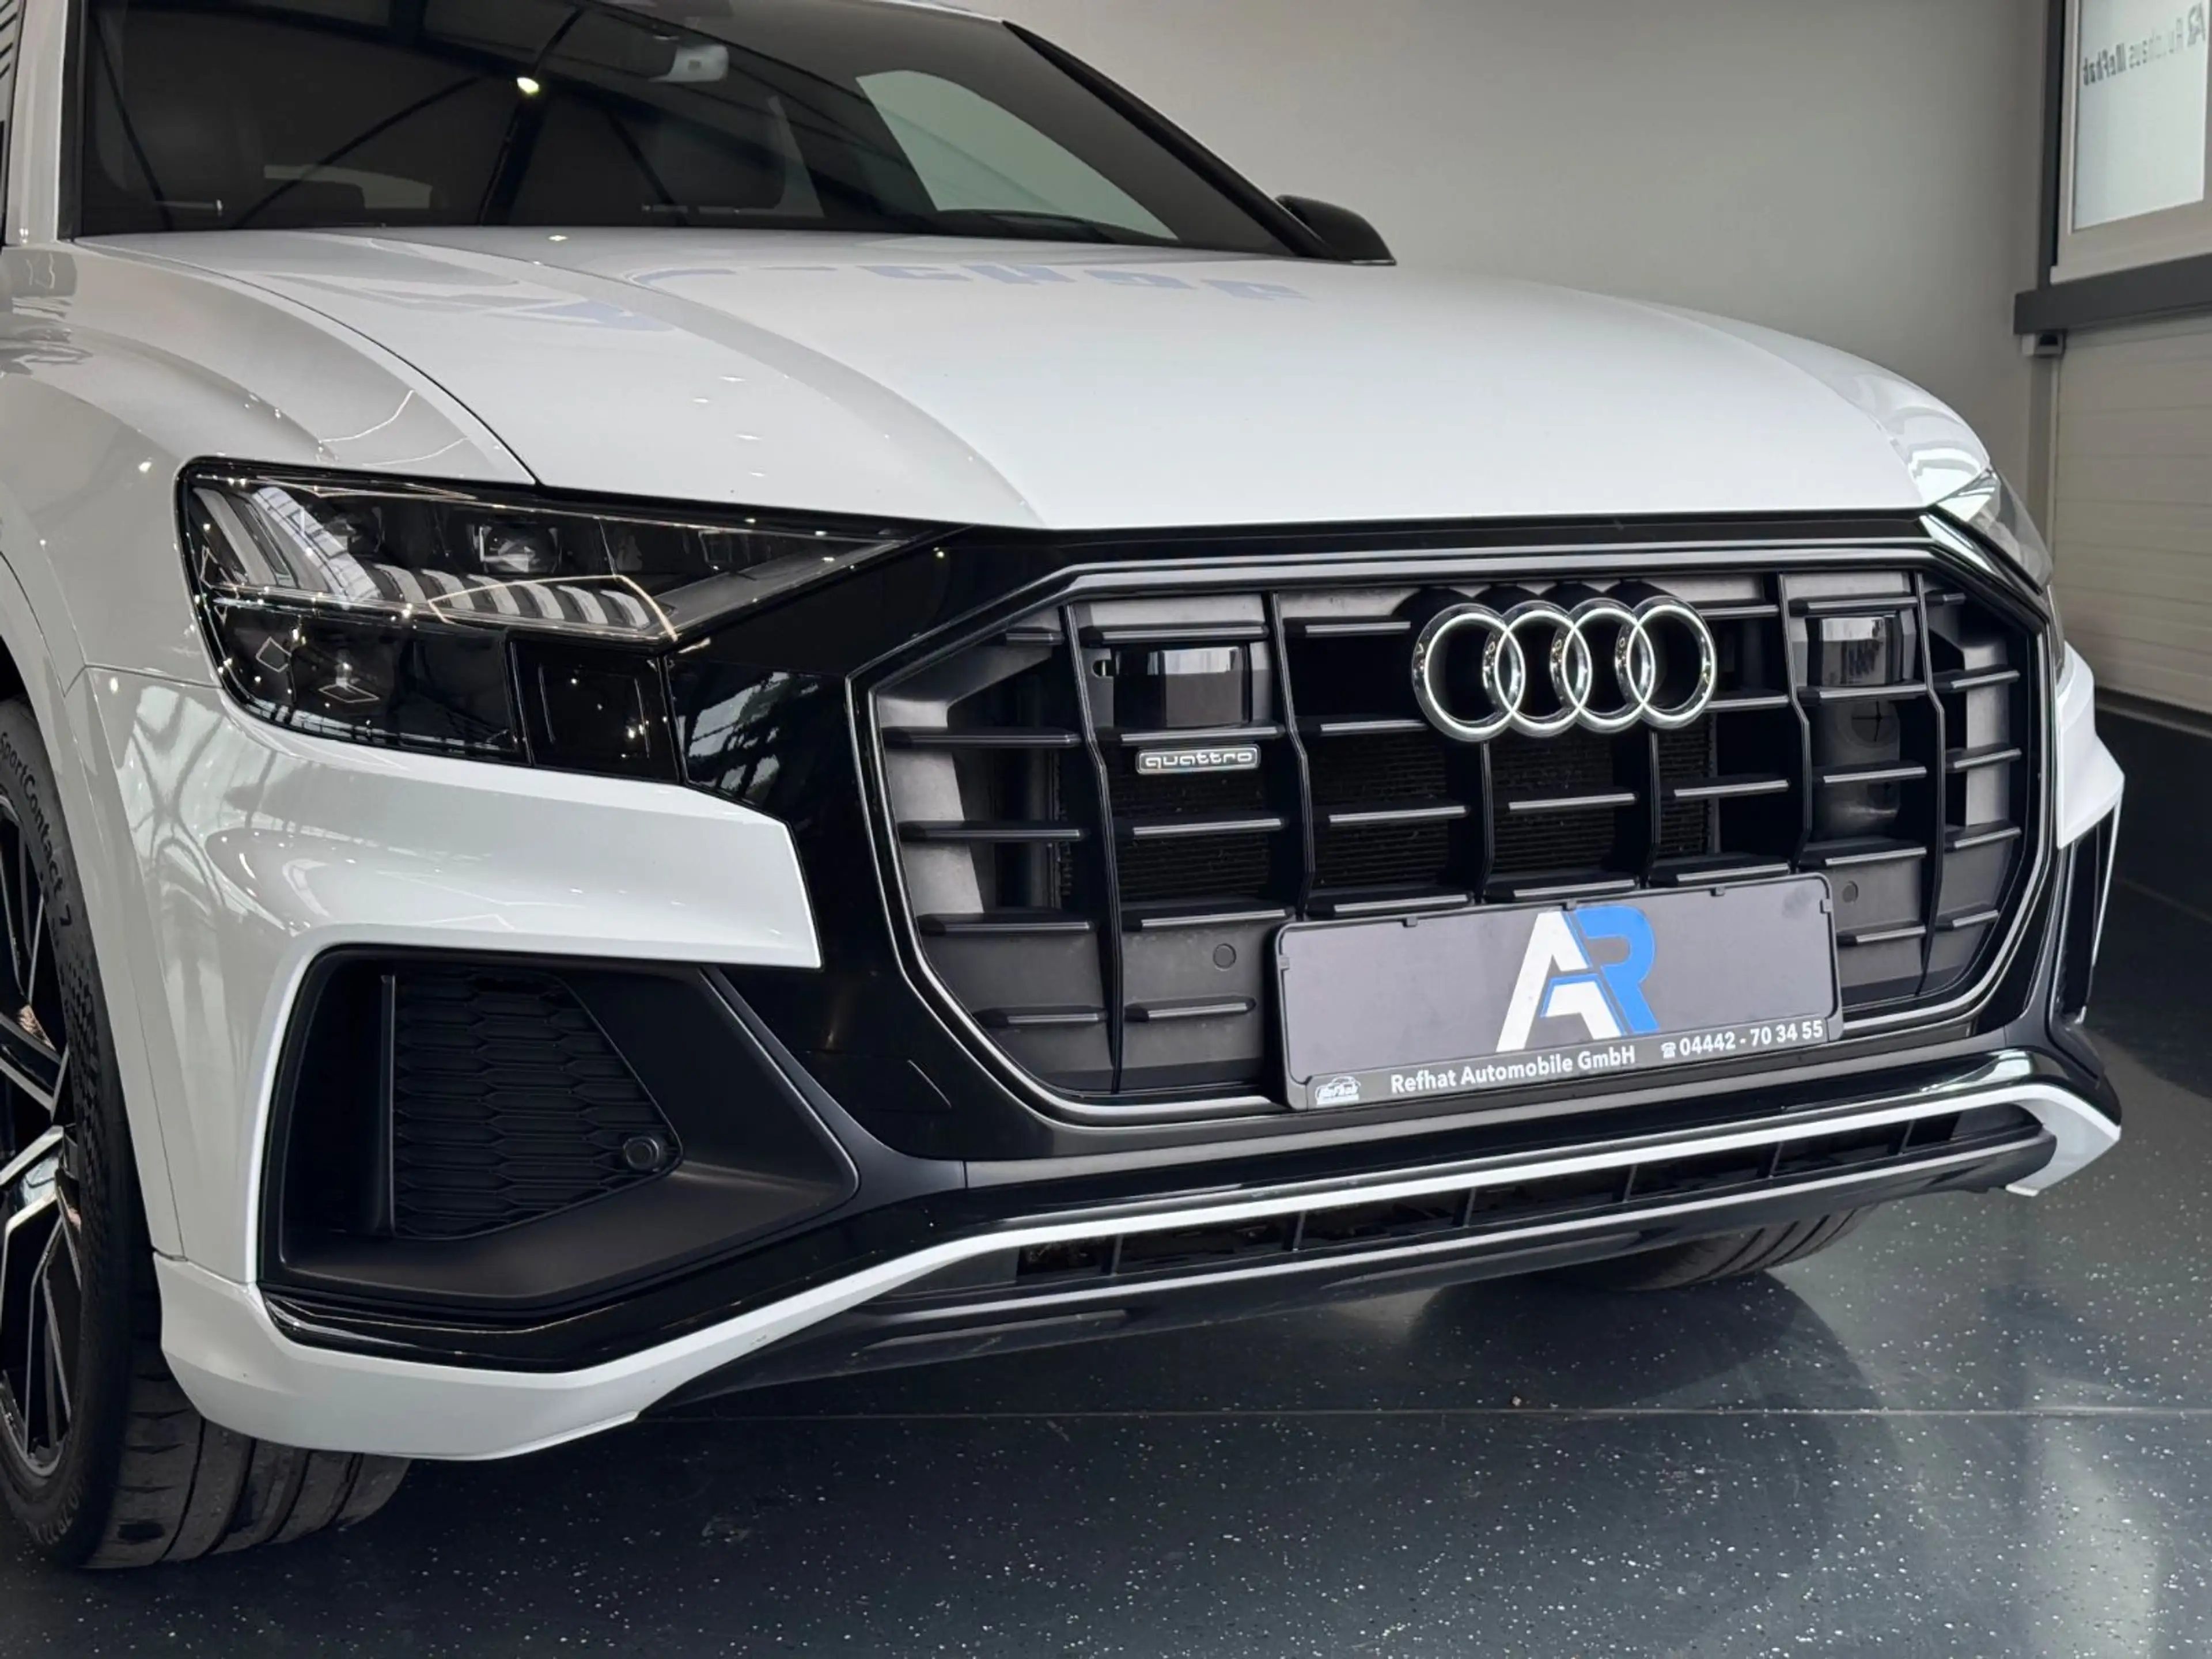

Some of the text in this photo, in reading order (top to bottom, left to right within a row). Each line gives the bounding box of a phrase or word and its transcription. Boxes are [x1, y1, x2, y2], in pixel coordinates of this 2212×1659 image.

[1145, 752, 1252, 769] quattro
[59, 902, 72, 927] 7
[1496, 903, 1660, 1052] AR
[1679, 1031, 1736, 1056] 04442
[1750, 1027, 1772, 1047] 70
[1776, 1024, 1798, 1043] 34
[1801, 1020, 1823, 1039] 55
[1390, 1045, 1635, 1093] Refhat Automobile GmbH
